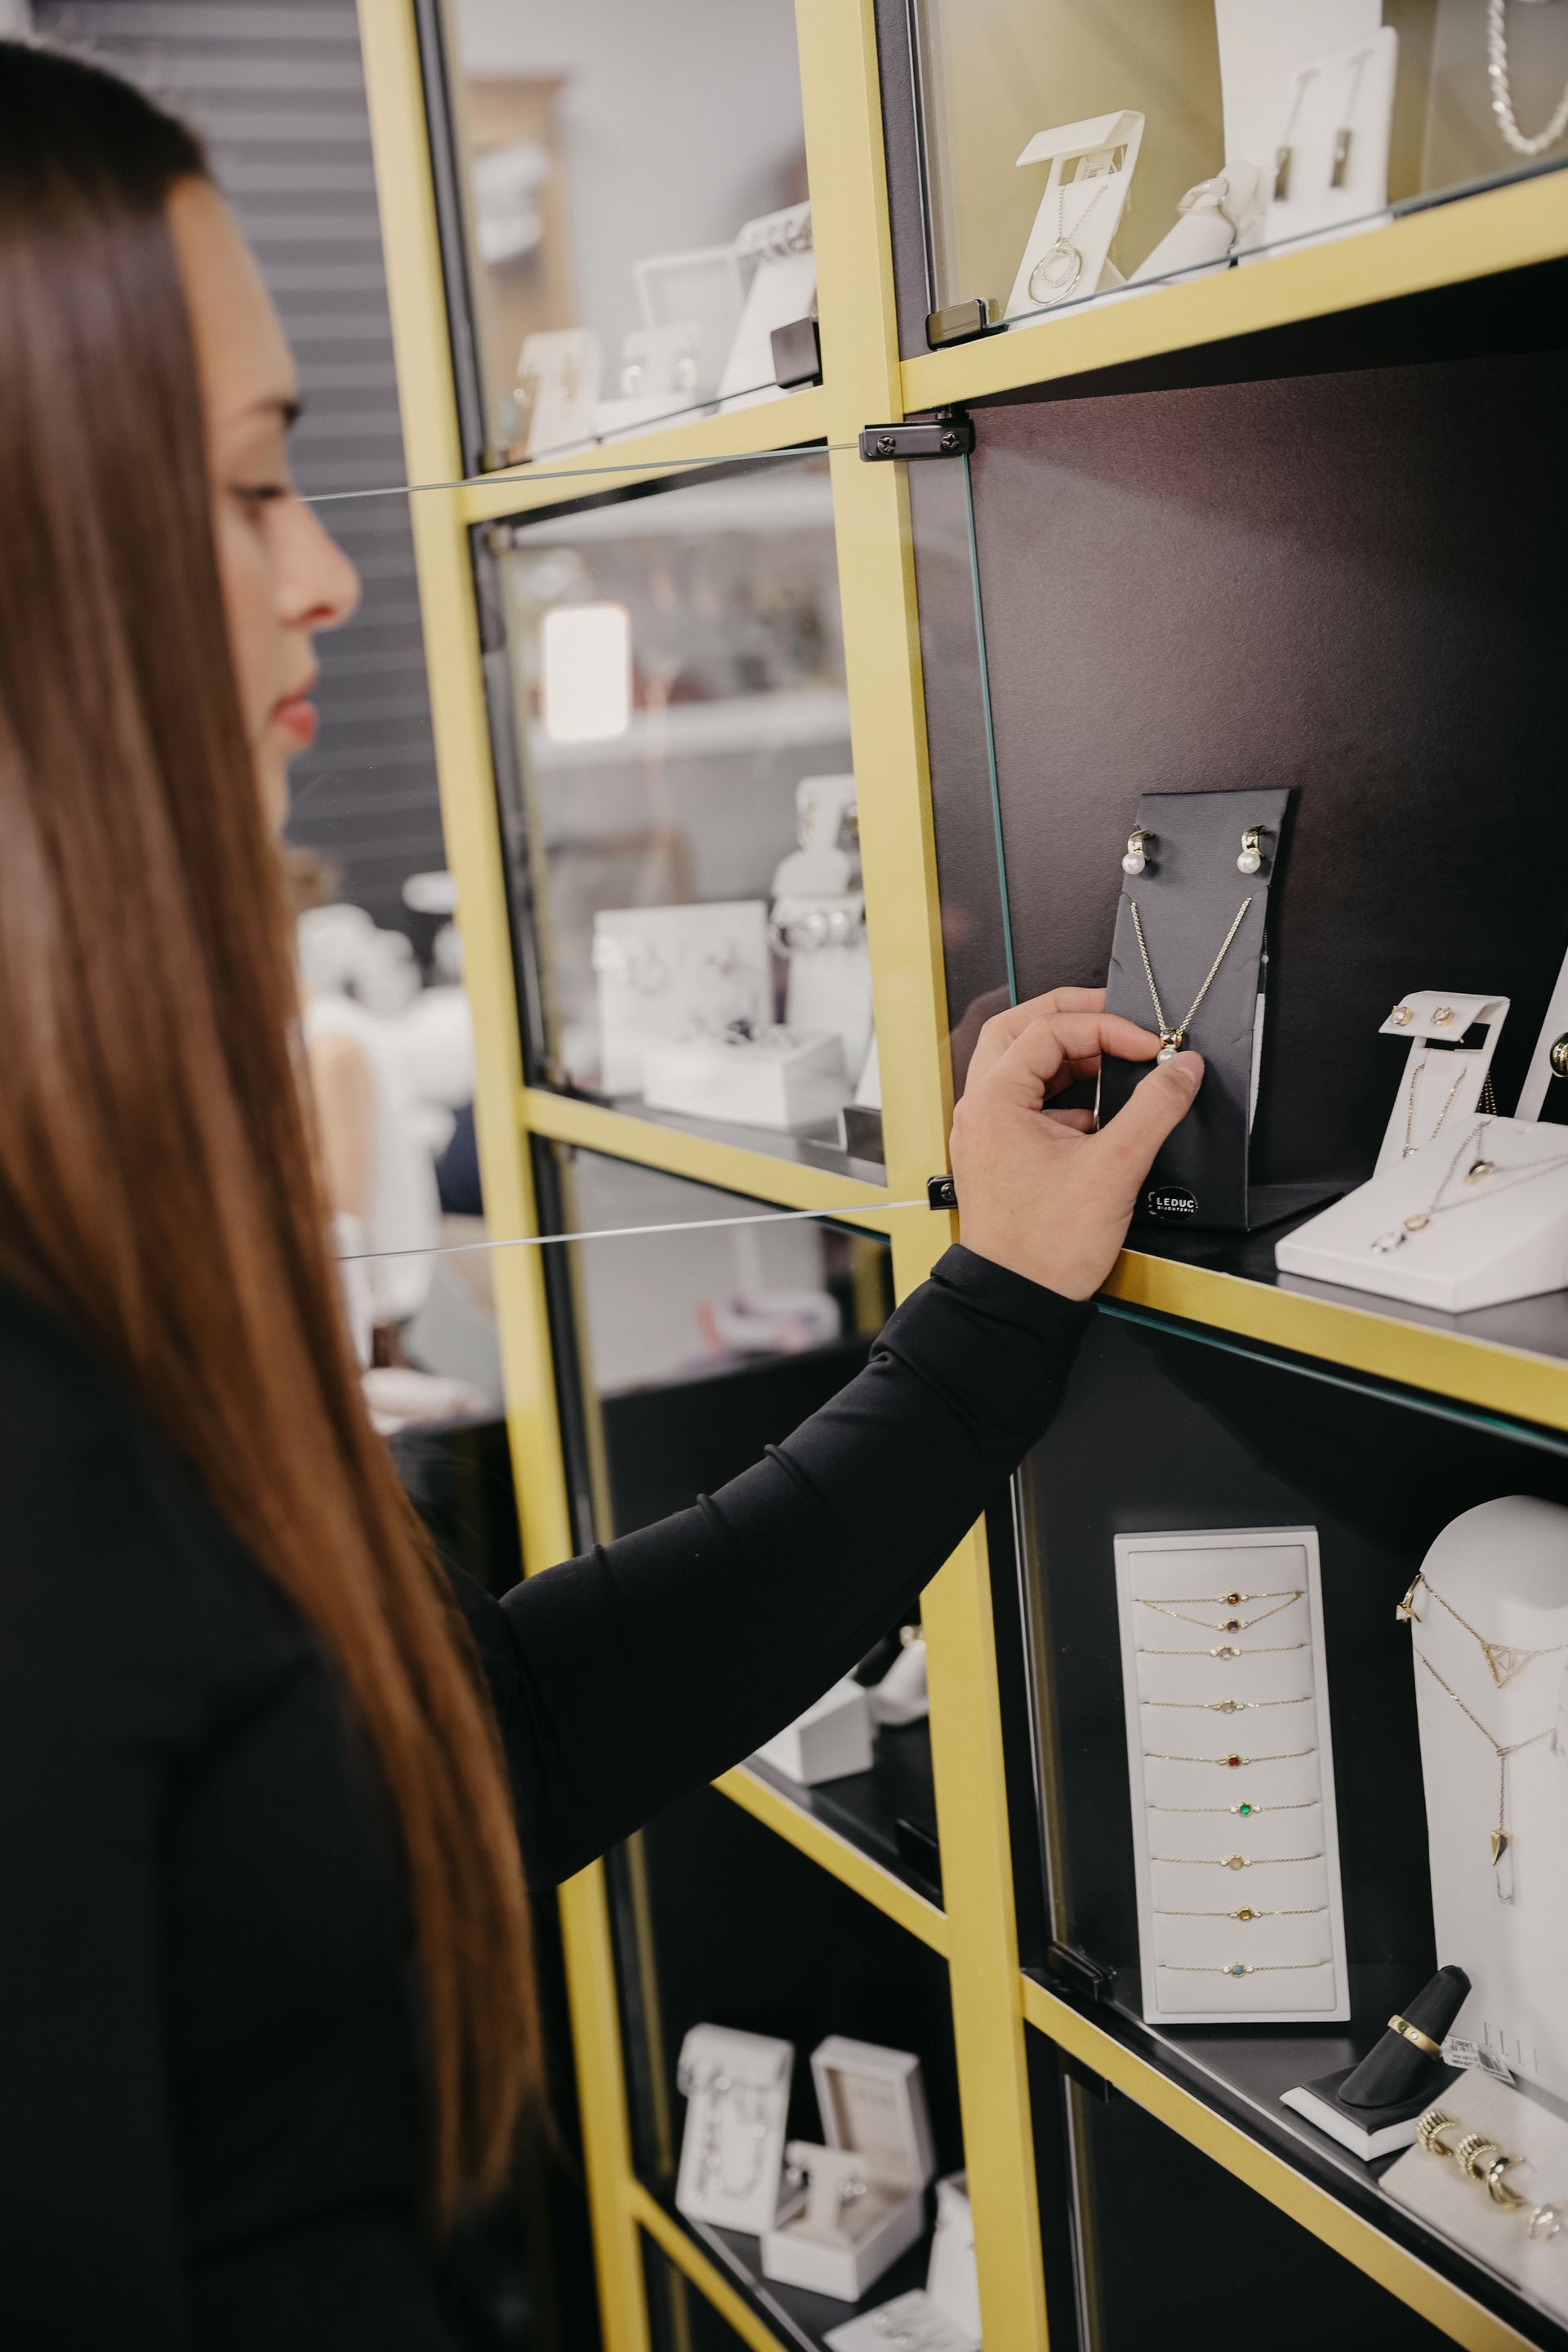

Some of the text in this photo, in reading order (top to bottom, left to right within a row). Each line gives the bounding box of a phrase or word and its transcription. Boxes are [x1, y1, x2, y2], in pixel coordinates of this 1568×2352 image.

[1156, 1197, 1195, 1209] LEDUC
[1156, 1205, 1195, 1214] BIJOUTERIE
[1483, 2021, 1543, 2076] ELLE
